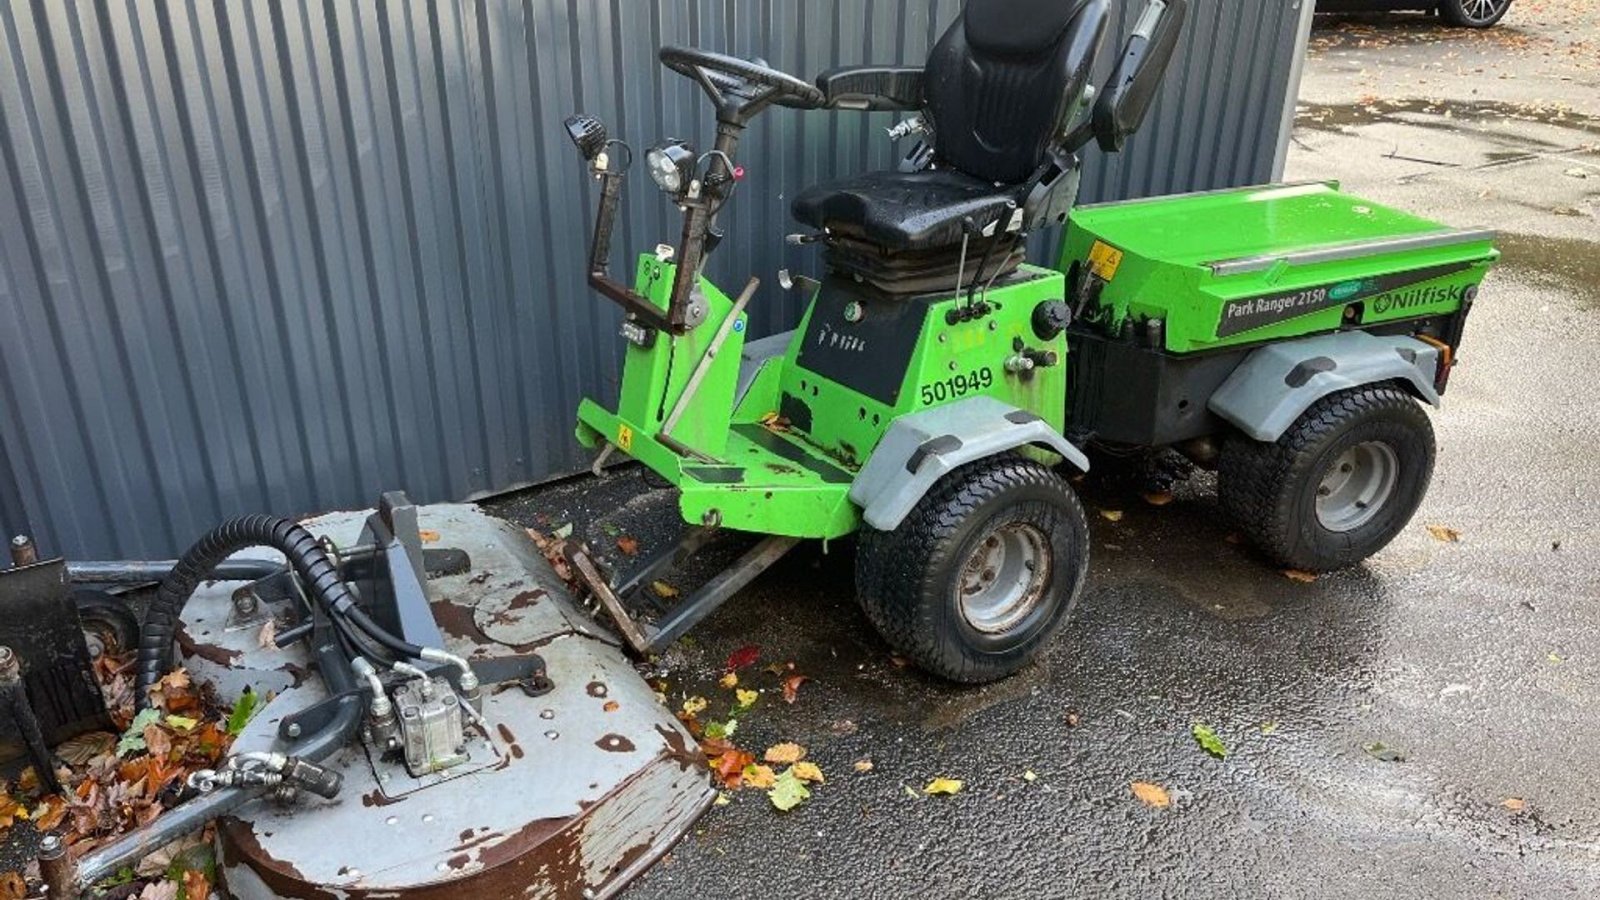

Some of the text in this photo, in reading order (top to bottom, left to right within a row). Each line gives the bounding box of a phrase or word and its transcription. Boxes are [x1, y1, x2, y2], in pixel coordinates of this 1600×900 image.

[1227, 300, 1254, 318] Park
[1255, 296, 1297, 314] Ranger
[1297, 288, 1326, 306] 2150
[1392, 284, 1461, 309] Nilfisk
[921, 367, 993, 405] 501949
